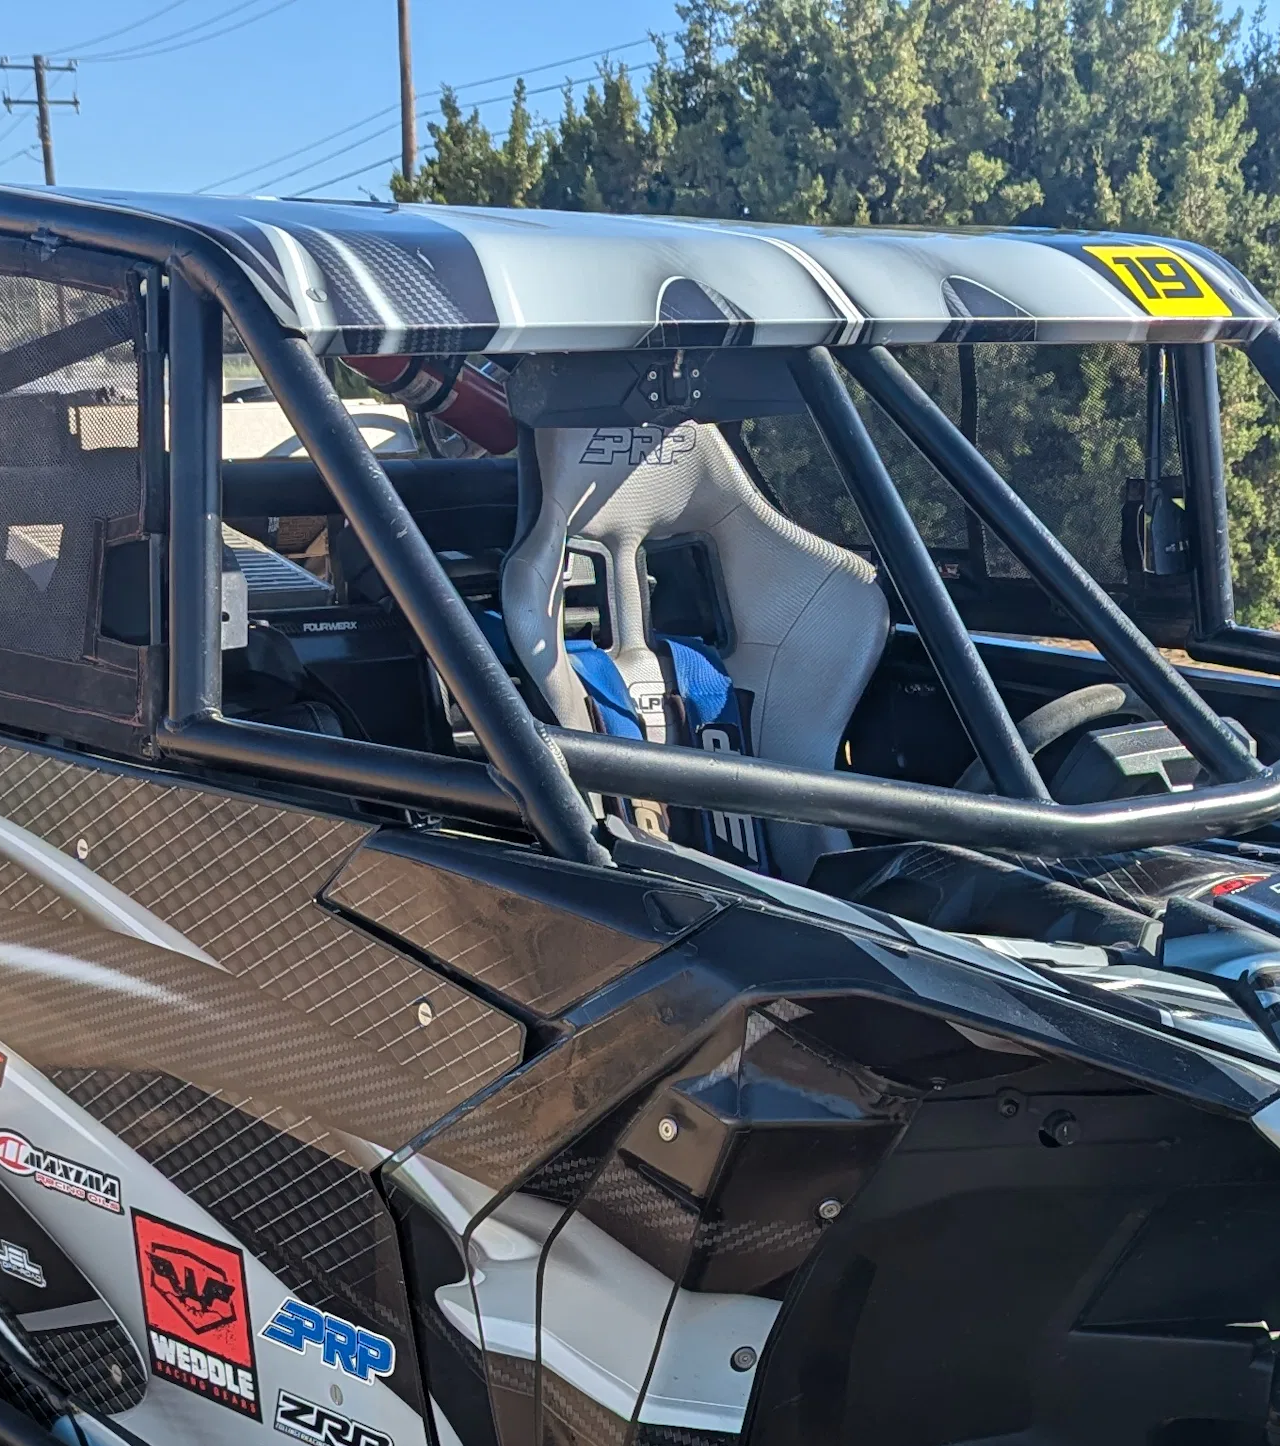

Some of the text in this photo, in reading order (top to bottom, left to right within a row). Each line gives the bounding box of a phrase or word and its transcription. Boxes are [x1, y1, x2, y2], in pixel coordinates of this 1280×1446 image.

[1112, 256, 1205, 299] 19
[579, 424, 697, 466] PRP
[303, 621, 357, 633] FOURWERX
[22, 1150, 119, 1199] MAXIMA
[35, 1173, 120, 1212] RACING OILS
[261, 1299, 394, 1382] PRP
[150, 1330, 255, 1401] WEDDLE
[156, 1361, 256, 1414] RACING GEARS
